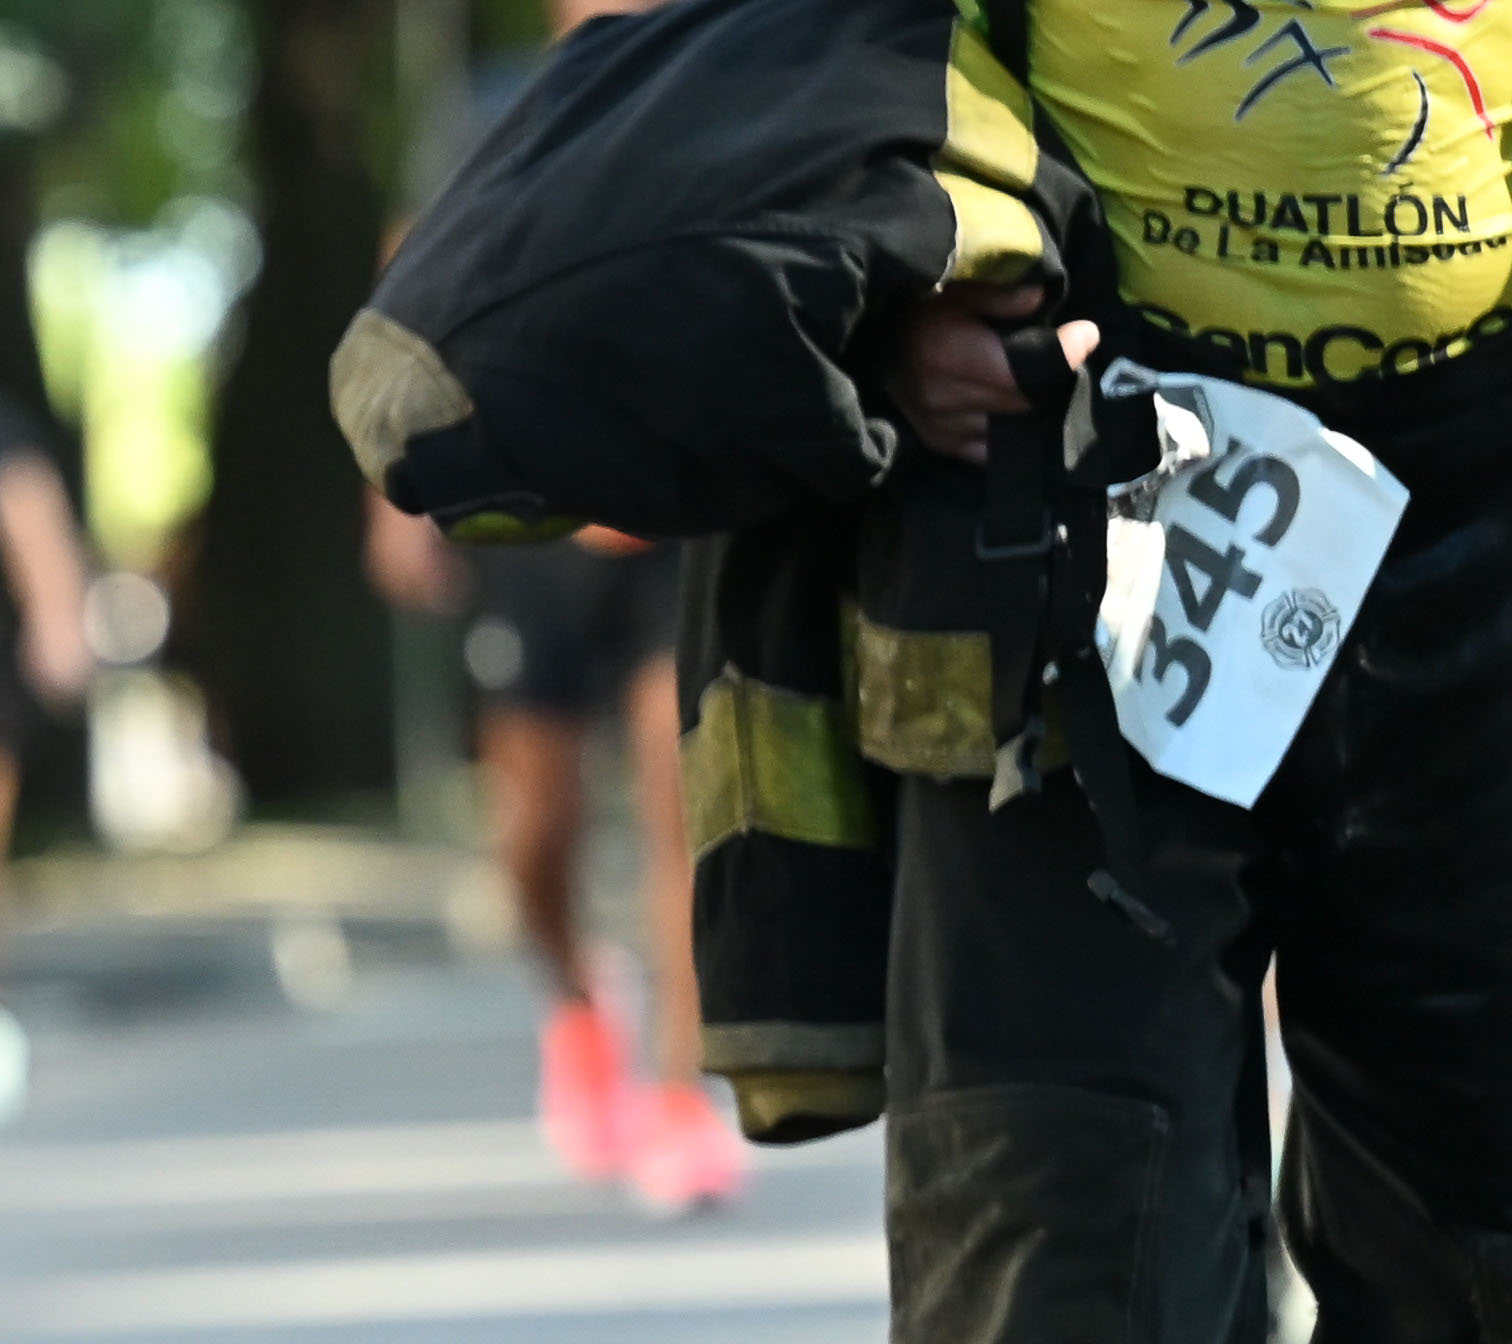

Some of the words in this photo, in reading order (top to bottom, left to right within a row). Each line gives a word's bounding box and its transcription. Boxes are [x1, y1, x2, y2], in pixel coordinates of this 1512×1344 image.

[1143, 209, 1200, 255] De
[1184, 181, 1471, 238] DUATLÓN
[1134, 436, 1300, 727] 345
